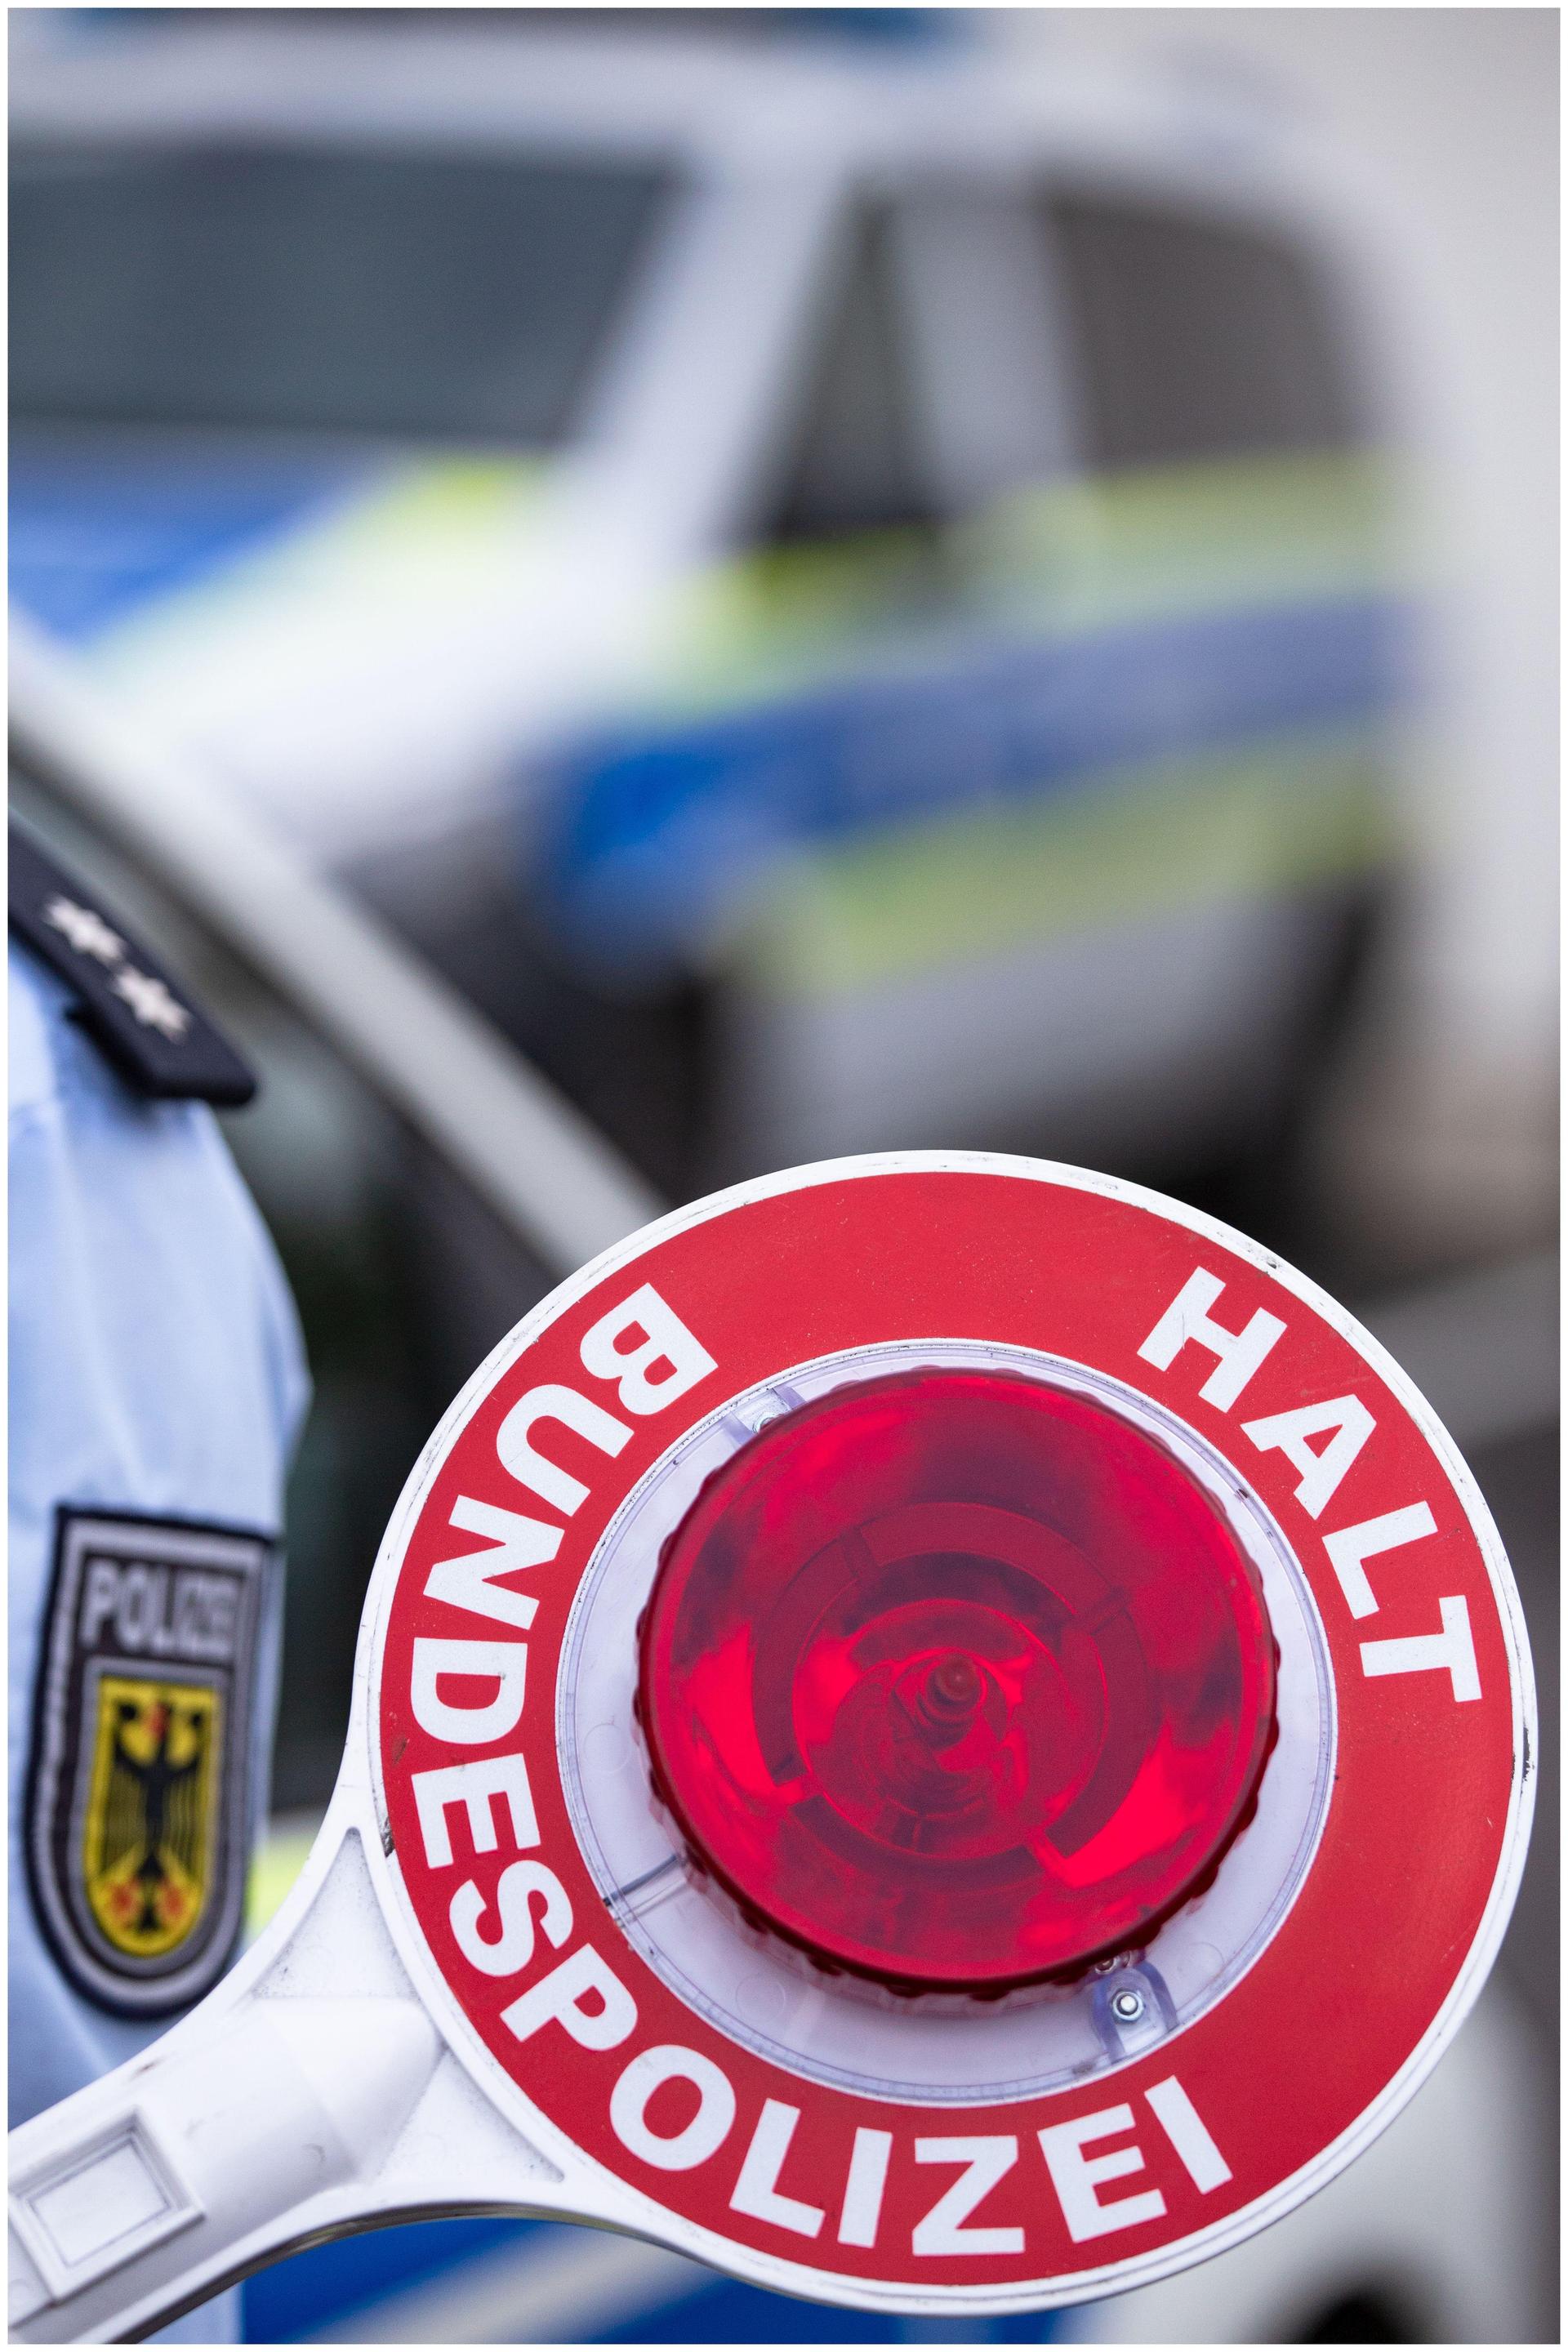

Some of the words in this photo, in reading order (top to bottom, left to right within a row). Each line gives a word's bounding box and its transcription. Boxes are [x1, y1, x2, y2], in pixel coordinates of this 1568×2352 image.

[82, 1557, 239, 1658] POLIZEI
[1138, 1266, 1482, 1703] HALT
[410, 1282, 1233, 2257] BUNDESPOLIZEI
